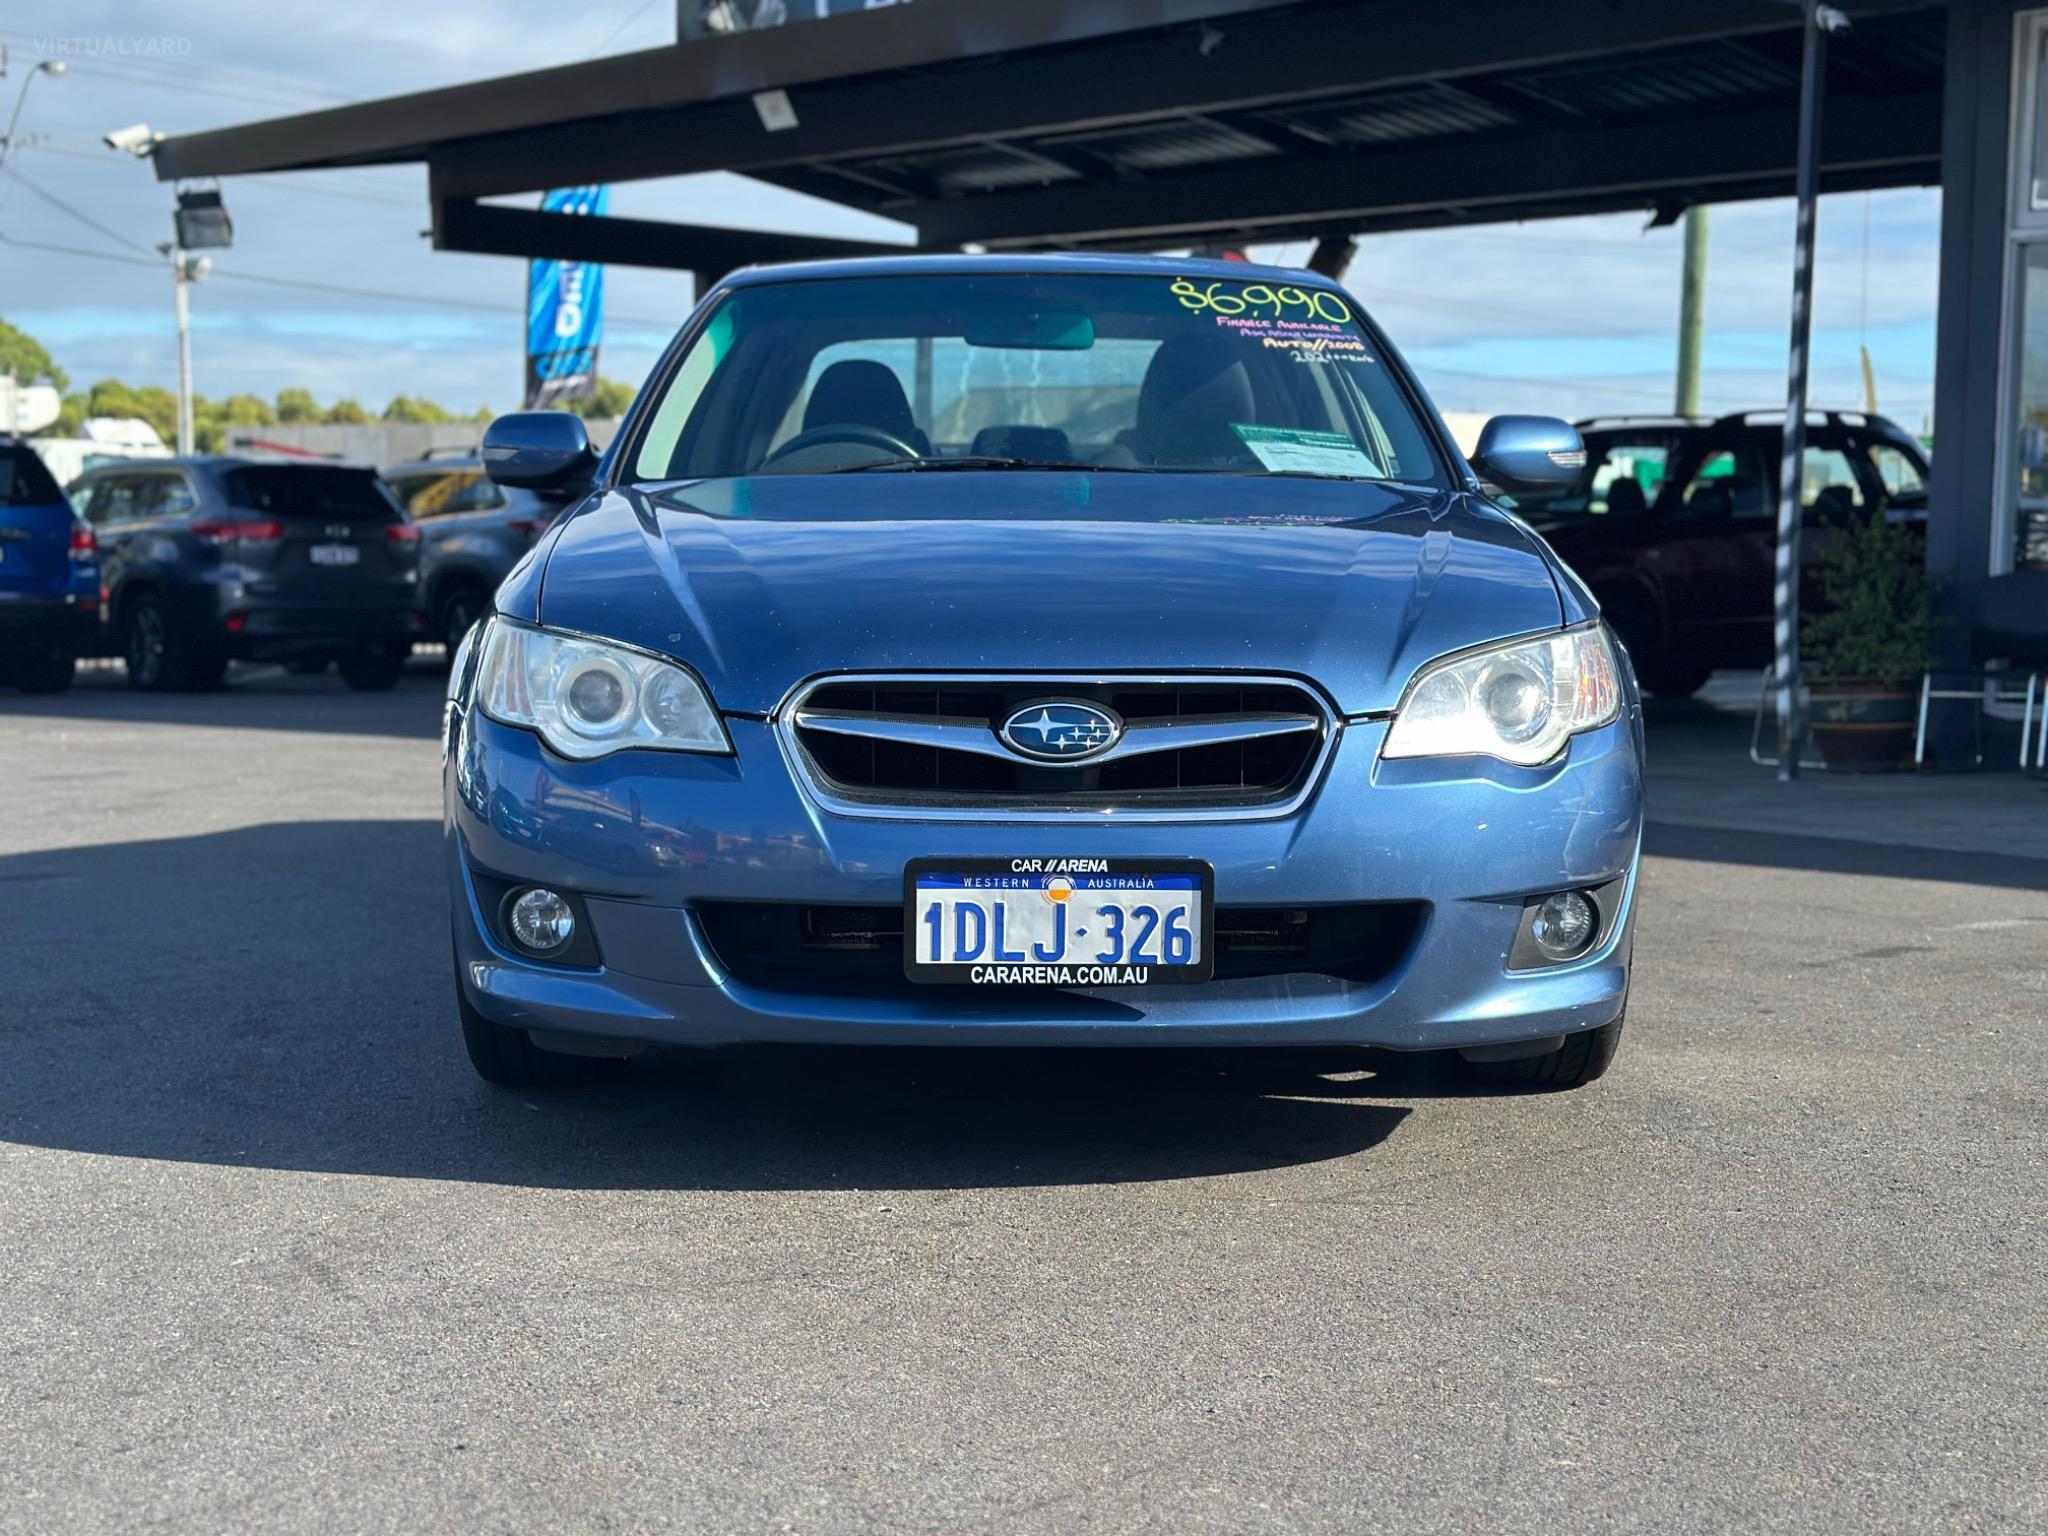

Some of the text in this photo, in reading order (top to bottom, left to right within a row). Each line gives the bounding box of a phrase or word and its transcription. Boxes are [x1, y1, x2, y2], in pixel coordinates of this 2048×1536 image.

[1216, 316, 1342, 332] FINANCE AVAILABLE
[963, 877, 1155, 889] WESTERN AUSTRALIA
[970, 966, 1148, 984] CARARENA.COM.AU
